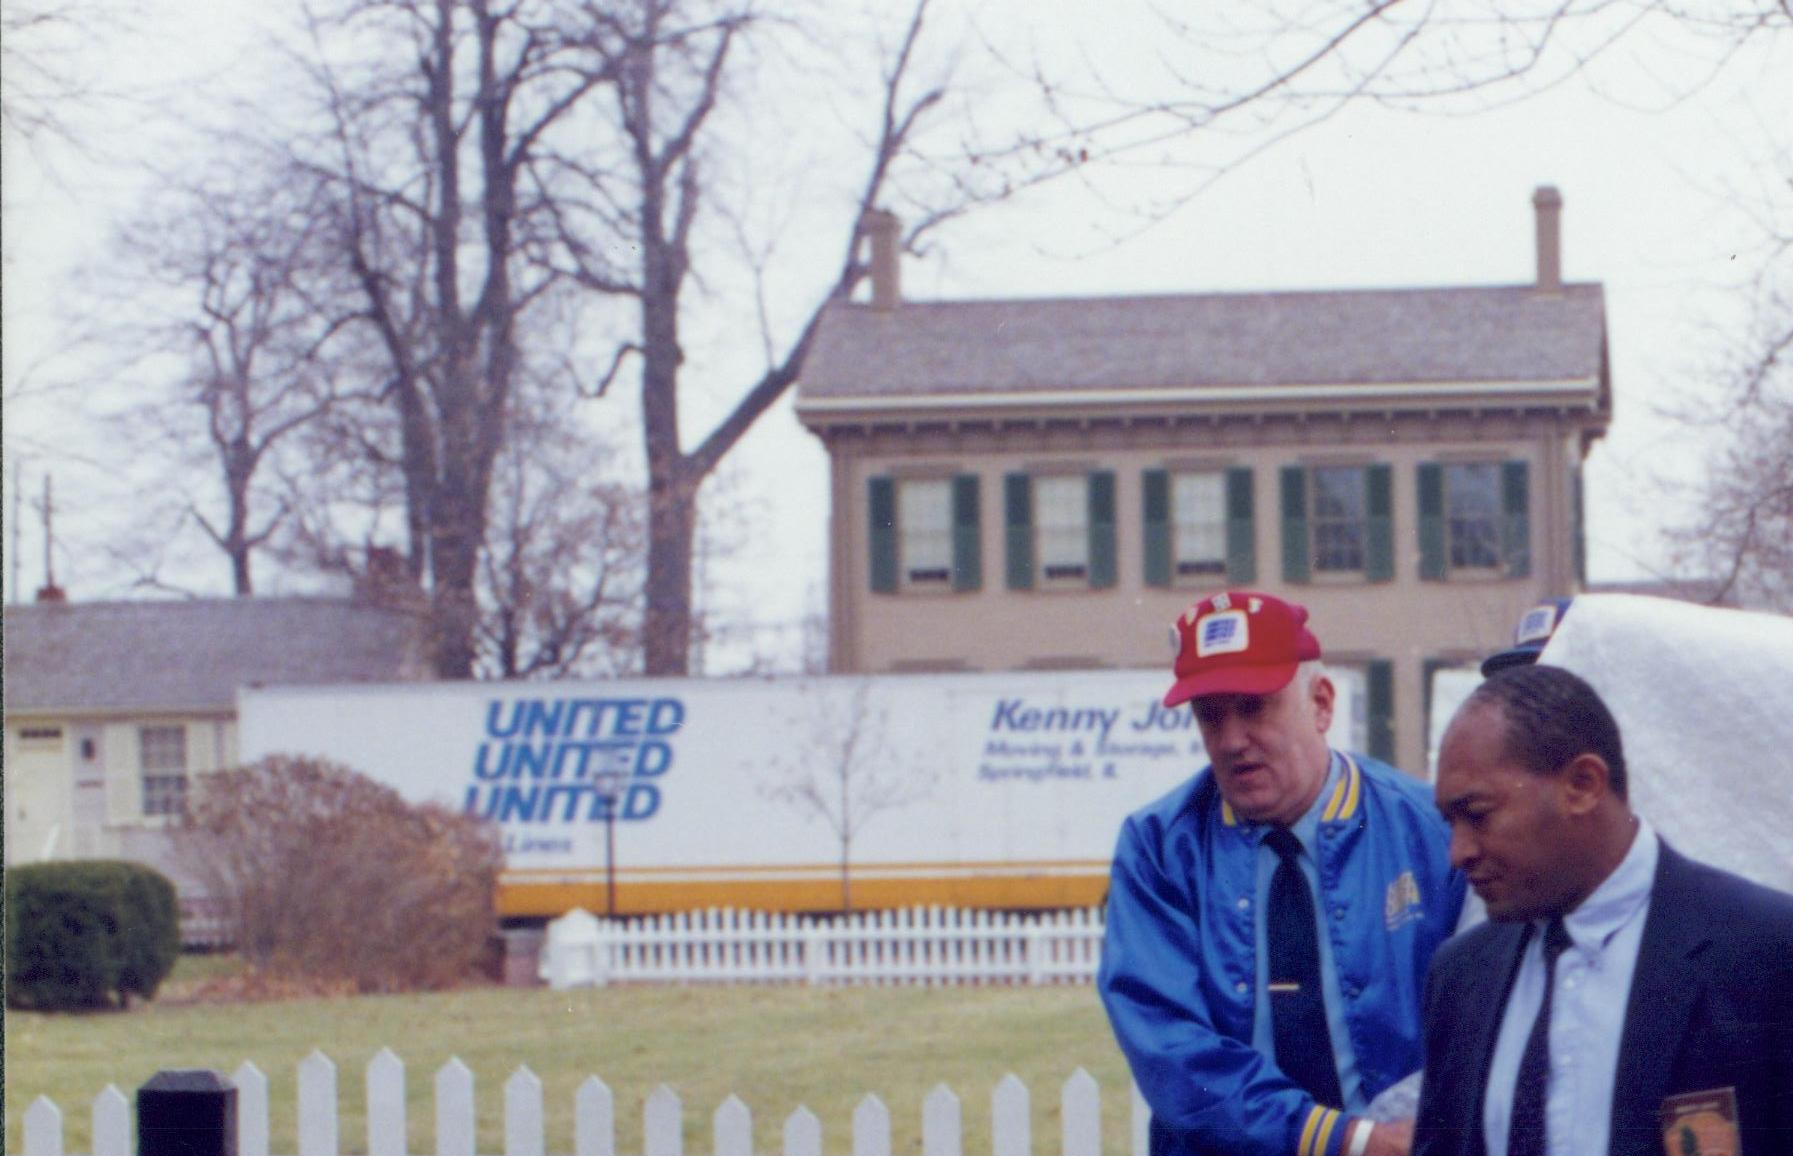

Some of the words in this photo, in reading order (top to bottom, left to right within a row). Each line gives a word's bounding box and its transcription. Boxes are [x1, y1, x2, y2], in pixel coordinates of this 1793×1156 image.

[487, 698, 685, 738] UNITED
[992, 699, 1120, 742] Kenny
[1071, 741, 1084, 756] &
[465, 783, 662, 822] UNITED
